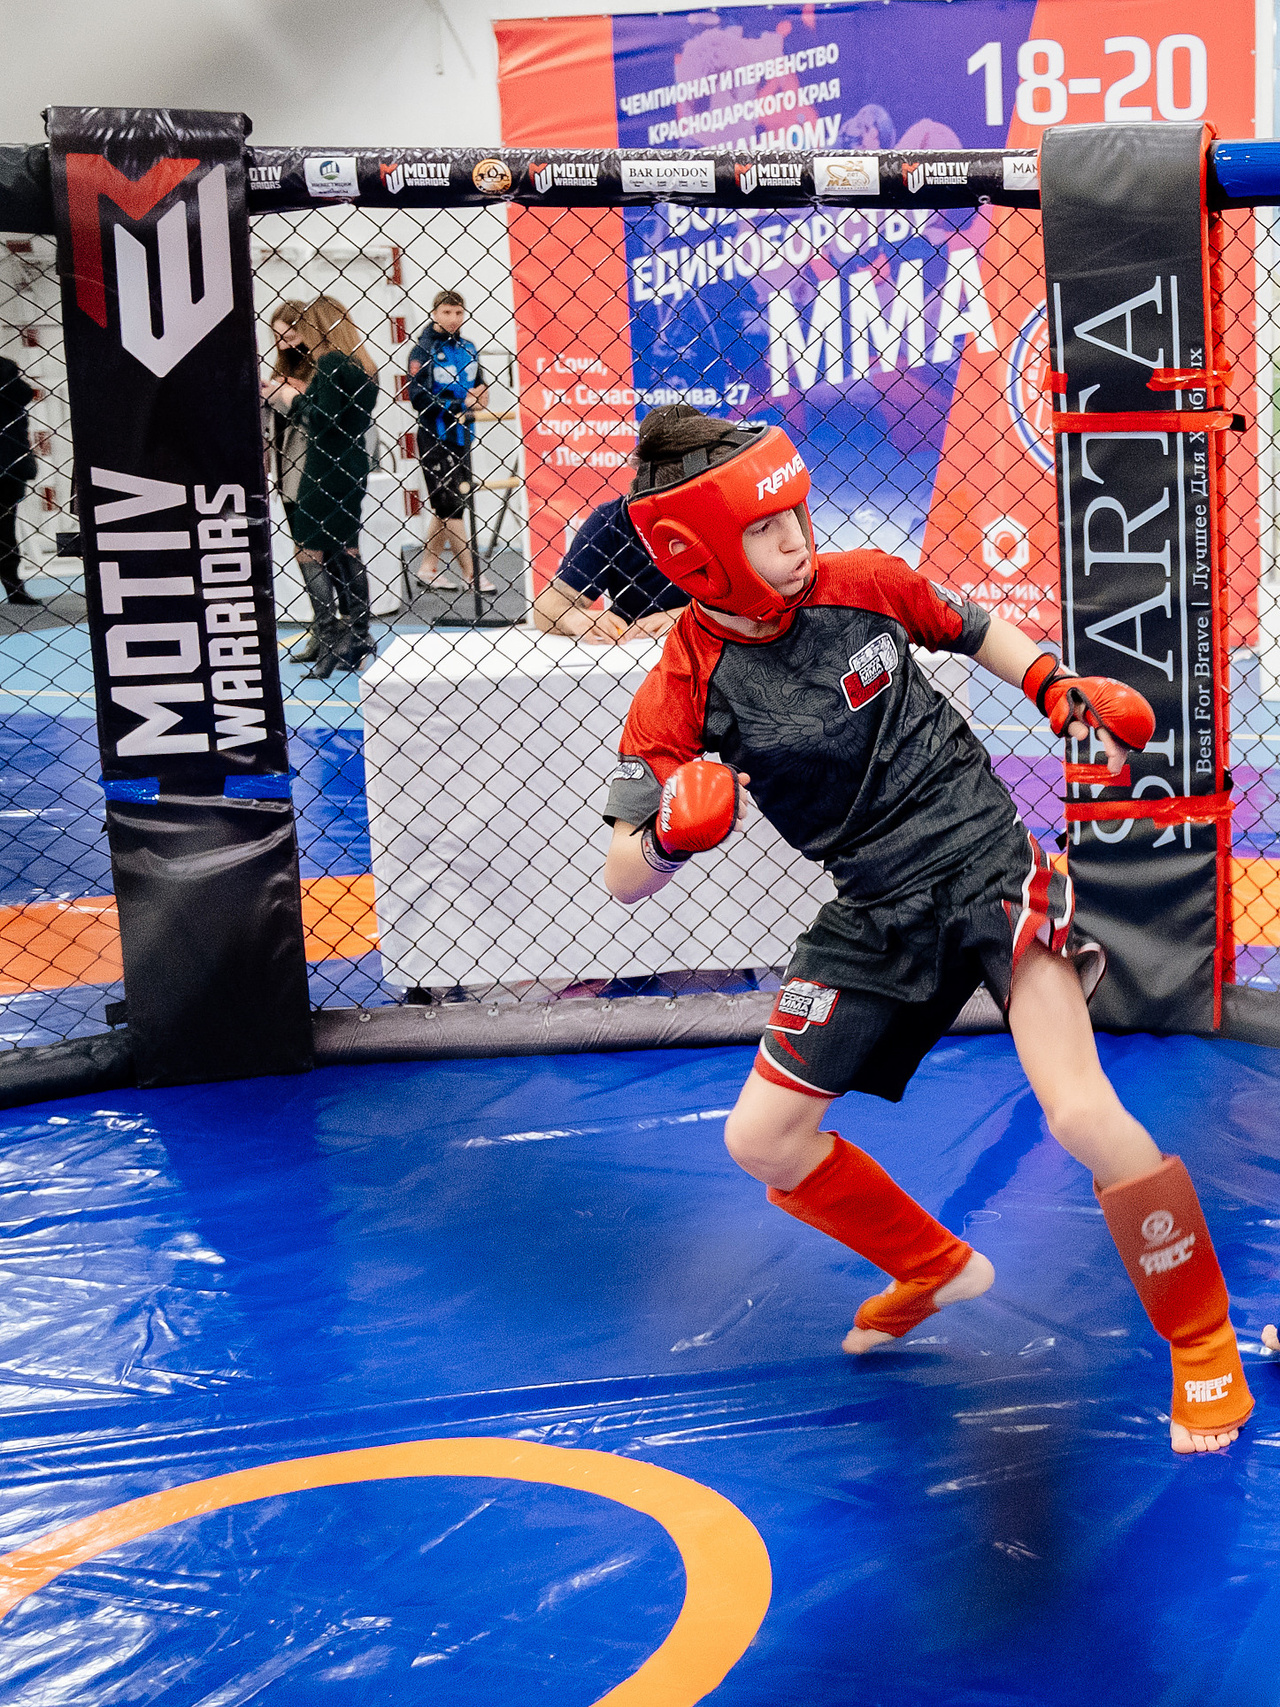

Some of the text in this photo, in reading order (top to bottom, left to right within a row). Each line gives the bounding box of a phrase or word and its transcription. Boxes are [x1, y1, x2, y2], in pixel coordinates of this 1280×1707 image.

[620, 43, 840, 117] ЧЕМПИОНАТ И ПЕРВЕНСТВО
[967, 33, 1208, 126] 18-20
[648, 78, 841, 146] КРАСНОДАРСКОГО КРАЯ
[247, 165, 282, 182] OTIV
[404, 162, 451, 178] MOTIV
[553, 163, 600, 178] MOTIV
[629, 167, 708, 178] BAR LONDON
[757, 163, 802, 178] MOTIV
[924, 162, 970, 177] MOTIV
[925, 176, 968, 186] WARRIORS
[405, 177, 450, 187] WARRIORS
[553, 177, 598, 187] WARRIORS
[758, 177, 802, 187] WARRIORS
[767, 248, 998, 398] ММА
[725, 383, 752, 406] 27
[755, 452, 806, 501] REYVE
[1190, 452, 1209, 497] Для
[1191, 504, 1213, 590] Лучшее
[90, 466, 210, 758] MOTIV
[194, 483, 268, 752] WARRIORS
[1194, 616, 1211, 679] Brave
[1195, 685, 1211, 723] For
[1195, 728, 1213, 775] Best
[1184, 1373, 1233, 1391] GREEN
[1186, 1384, 1229, 1403] HILL
